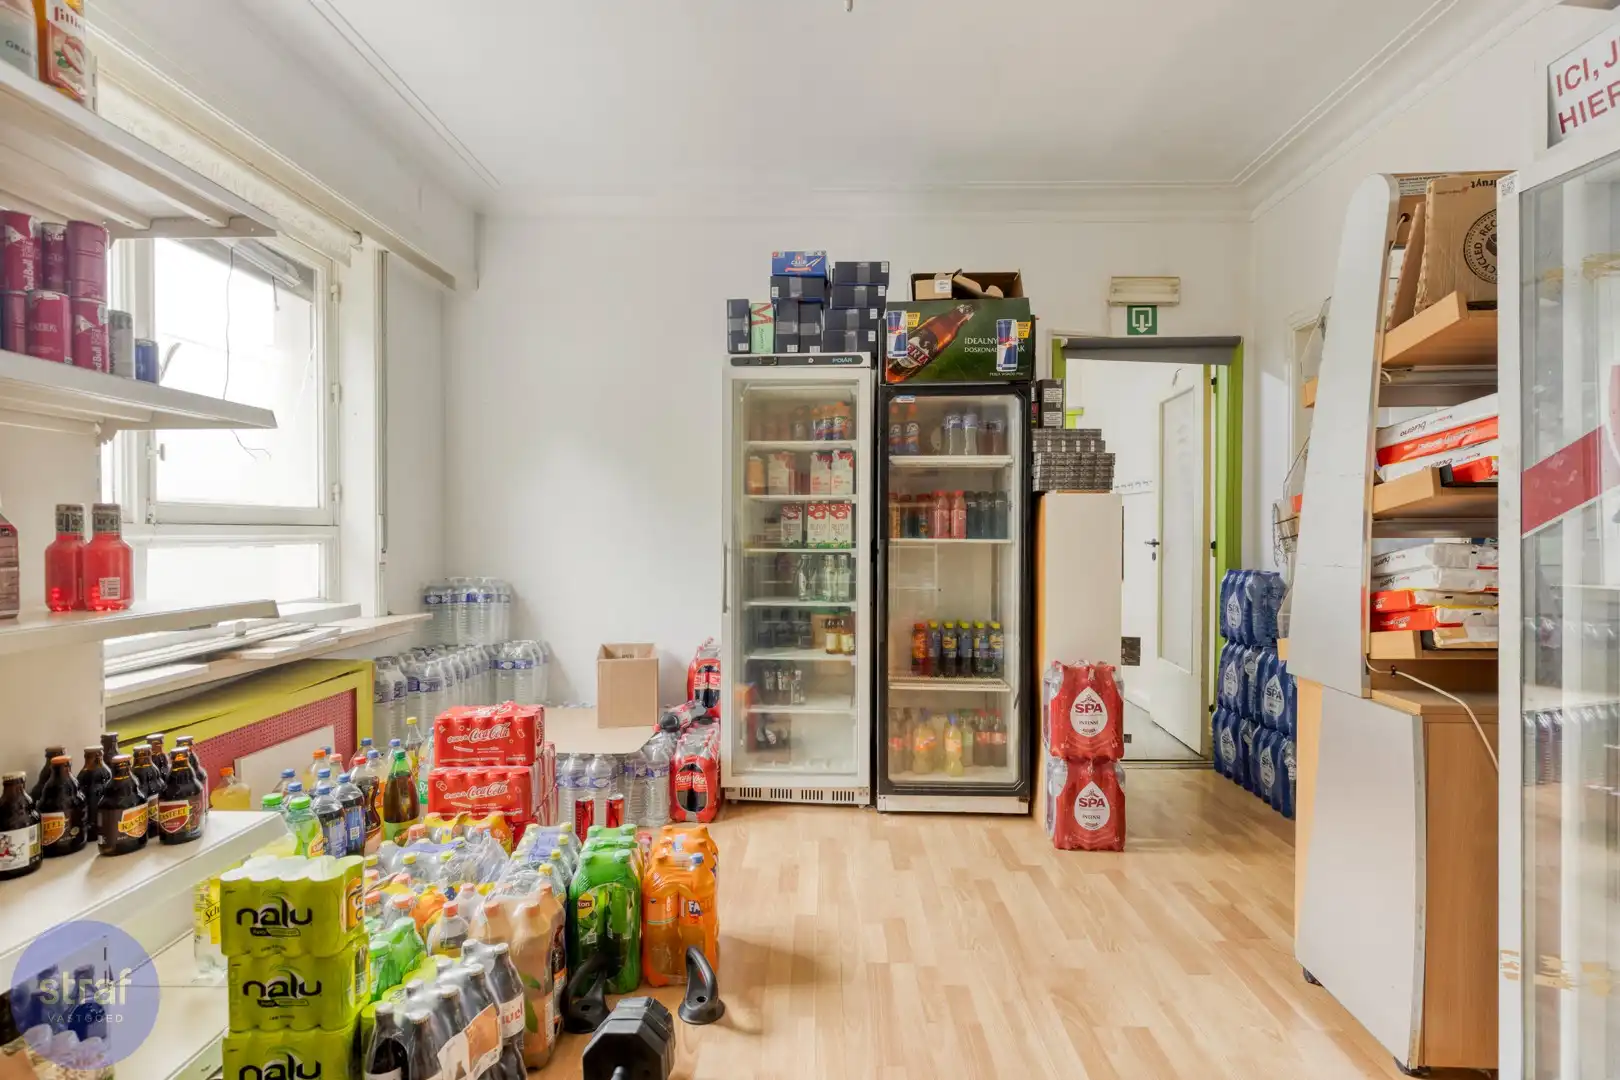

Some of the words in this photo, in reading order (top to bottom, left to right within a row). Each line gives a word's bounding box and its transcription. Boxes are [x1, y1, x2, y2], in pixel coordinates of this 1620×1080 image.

[1556, 57, 1600, 97] ICI,
[1479, 219, 1497, 236] REC
[22, 257, 34, 274] Bull
[1473, 241, 1497, 274] CYCLED
[1227, 603, 1240, 613] SPA
[1266, 686, 1282, 701] SPA
[1075, 703, 1103, 714] SPA
[469, 721, 511, 743] Coca-Cola
[467, 779, 510, 800] Coca-Cola
[1079, 797, 1106, 808] SPA
[235, 896, 313, 928] nalu
[687, 900, 701, 913] FA
[242, 970, 323, 998] nalu
[238, 1052, 322, 1080] nalu
